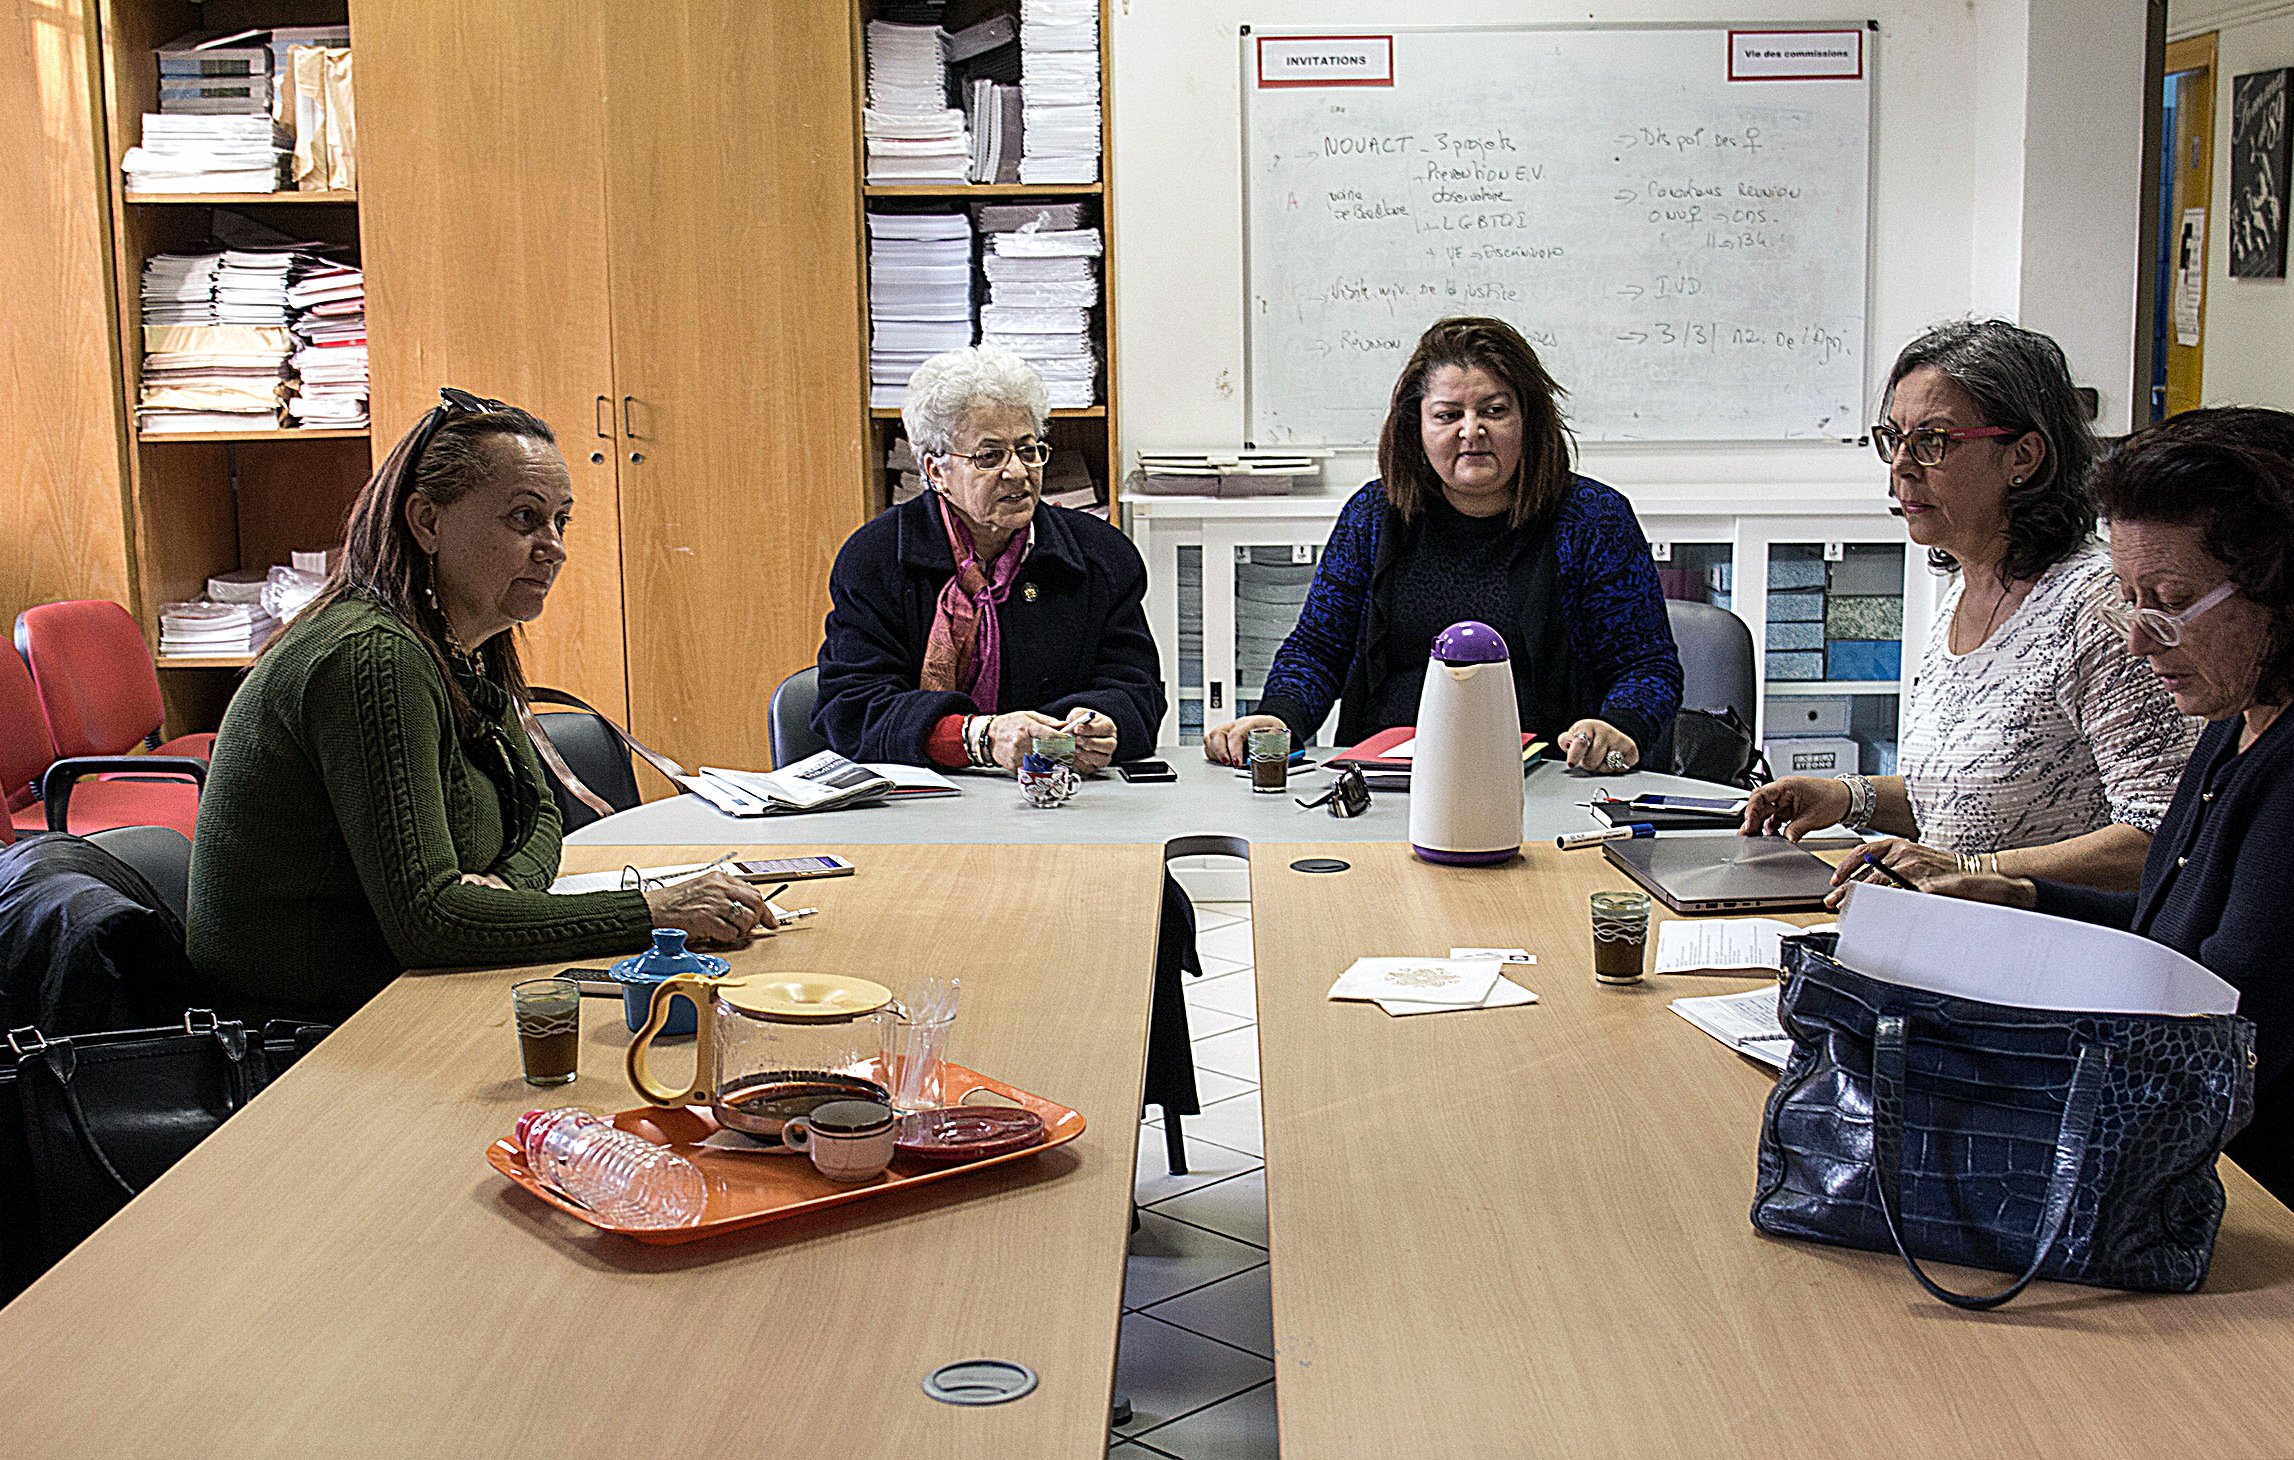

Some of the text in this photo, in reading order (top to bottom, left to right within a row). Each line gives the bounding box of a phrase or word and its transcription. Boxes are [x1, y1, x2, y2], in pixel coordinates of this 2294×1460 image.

[1745, 50, 1849, 58] Vie des commissions
[1286, 56, 1367, 66] INVITATIONS
